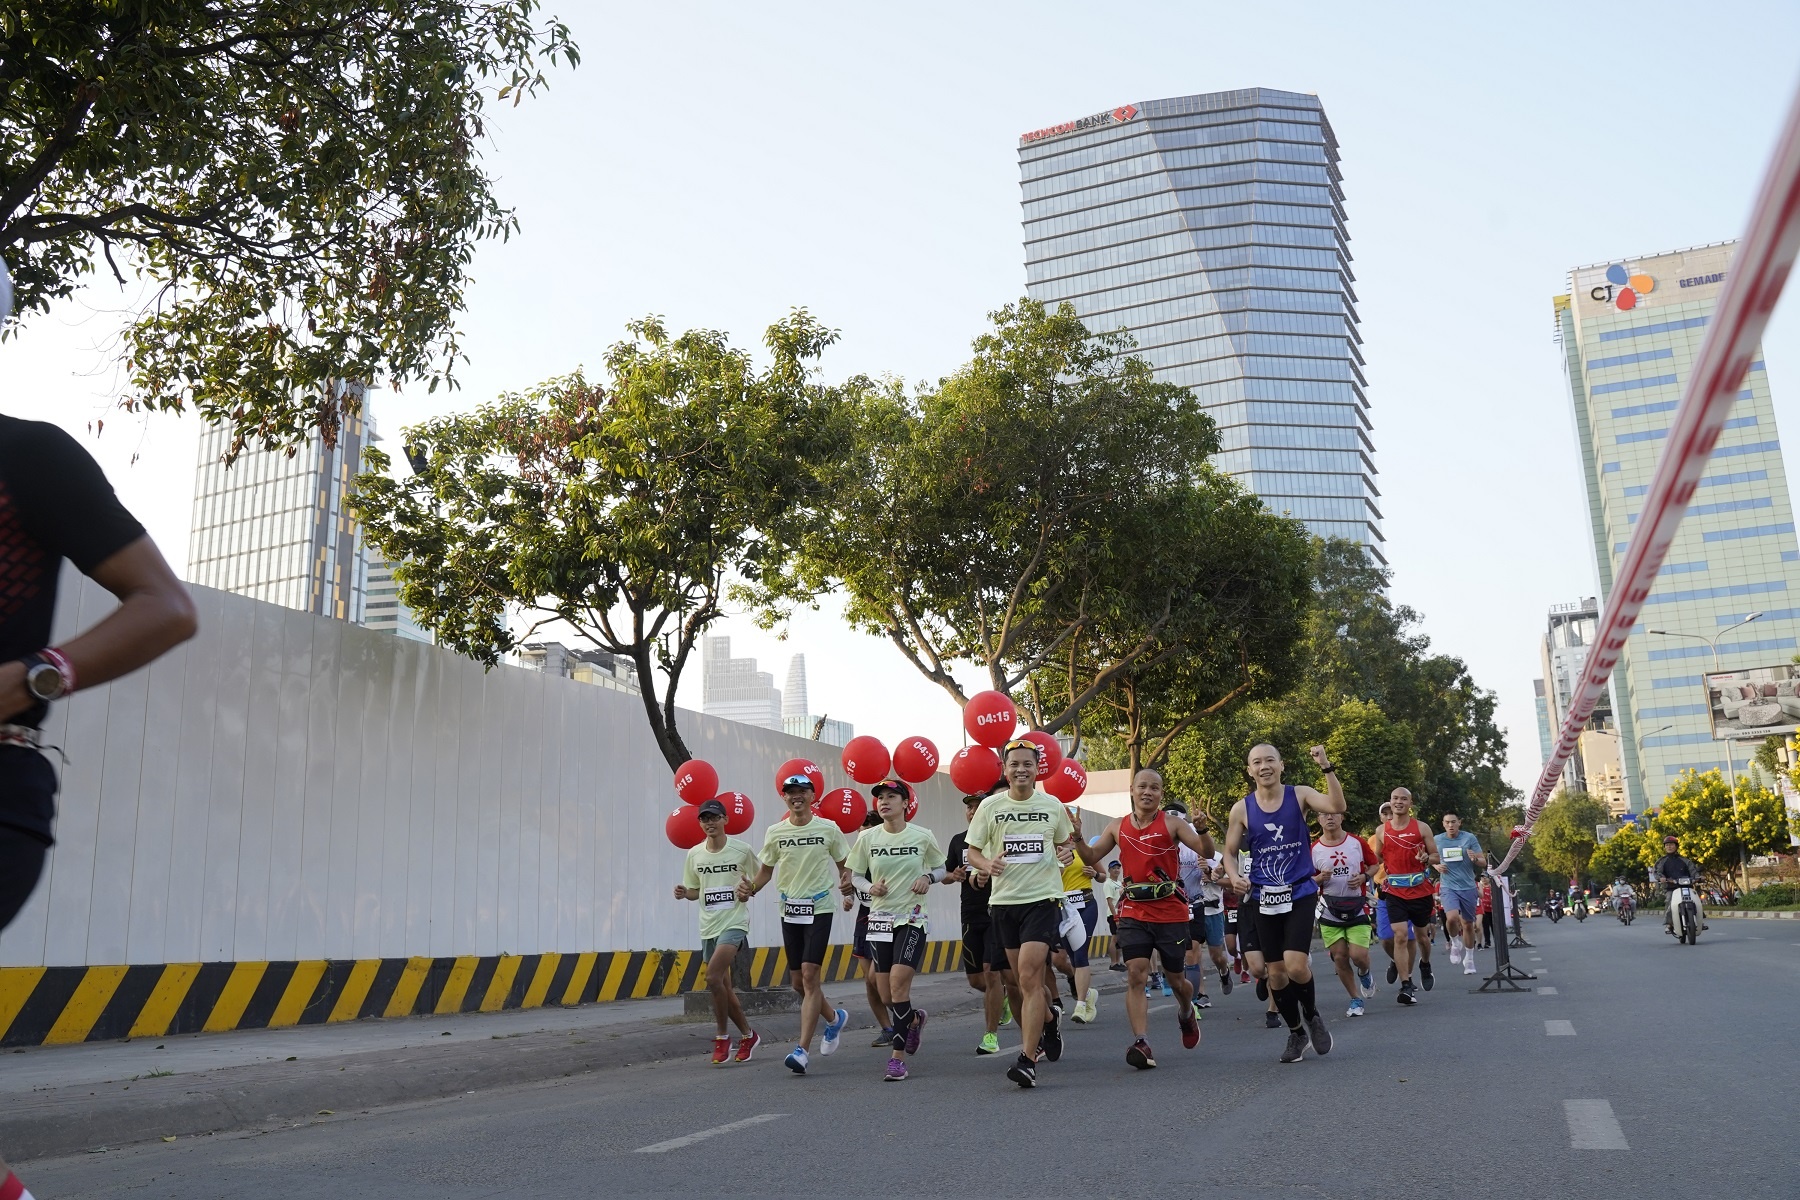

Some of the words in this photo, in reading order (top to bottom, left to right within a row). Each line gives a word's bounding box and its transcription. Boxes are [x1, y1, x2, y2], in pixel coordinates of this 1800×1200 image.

[1021, 112, 1110, 144] TECHCOMBANK
[1679, 272, 1728, 289] GEMADE
[1591, 284, 1613, 303] CJ
[977, 711, 1011, 726] 04:15
[913, 741, 936, 767] 04:15
[1036, 744, 1049, 775] 04:15
[1063, 766, 1087, 788] 04:15
[841, 789, 852, 815] 04:15
[995, 812, 1049, 825] PACER
[778, 836, 825, 849] PACER
[1005, 842, 1042, 853] PACER
[1257, 841, 1302, 854] VietRunners
[870, 846, 919, 857] PACER
[697, 863, 738, 875] PACER
[705, 892, 733, 902] PACER
[785, 905, 813, 915] PACER
[867, 921, 892, 932] PACER
